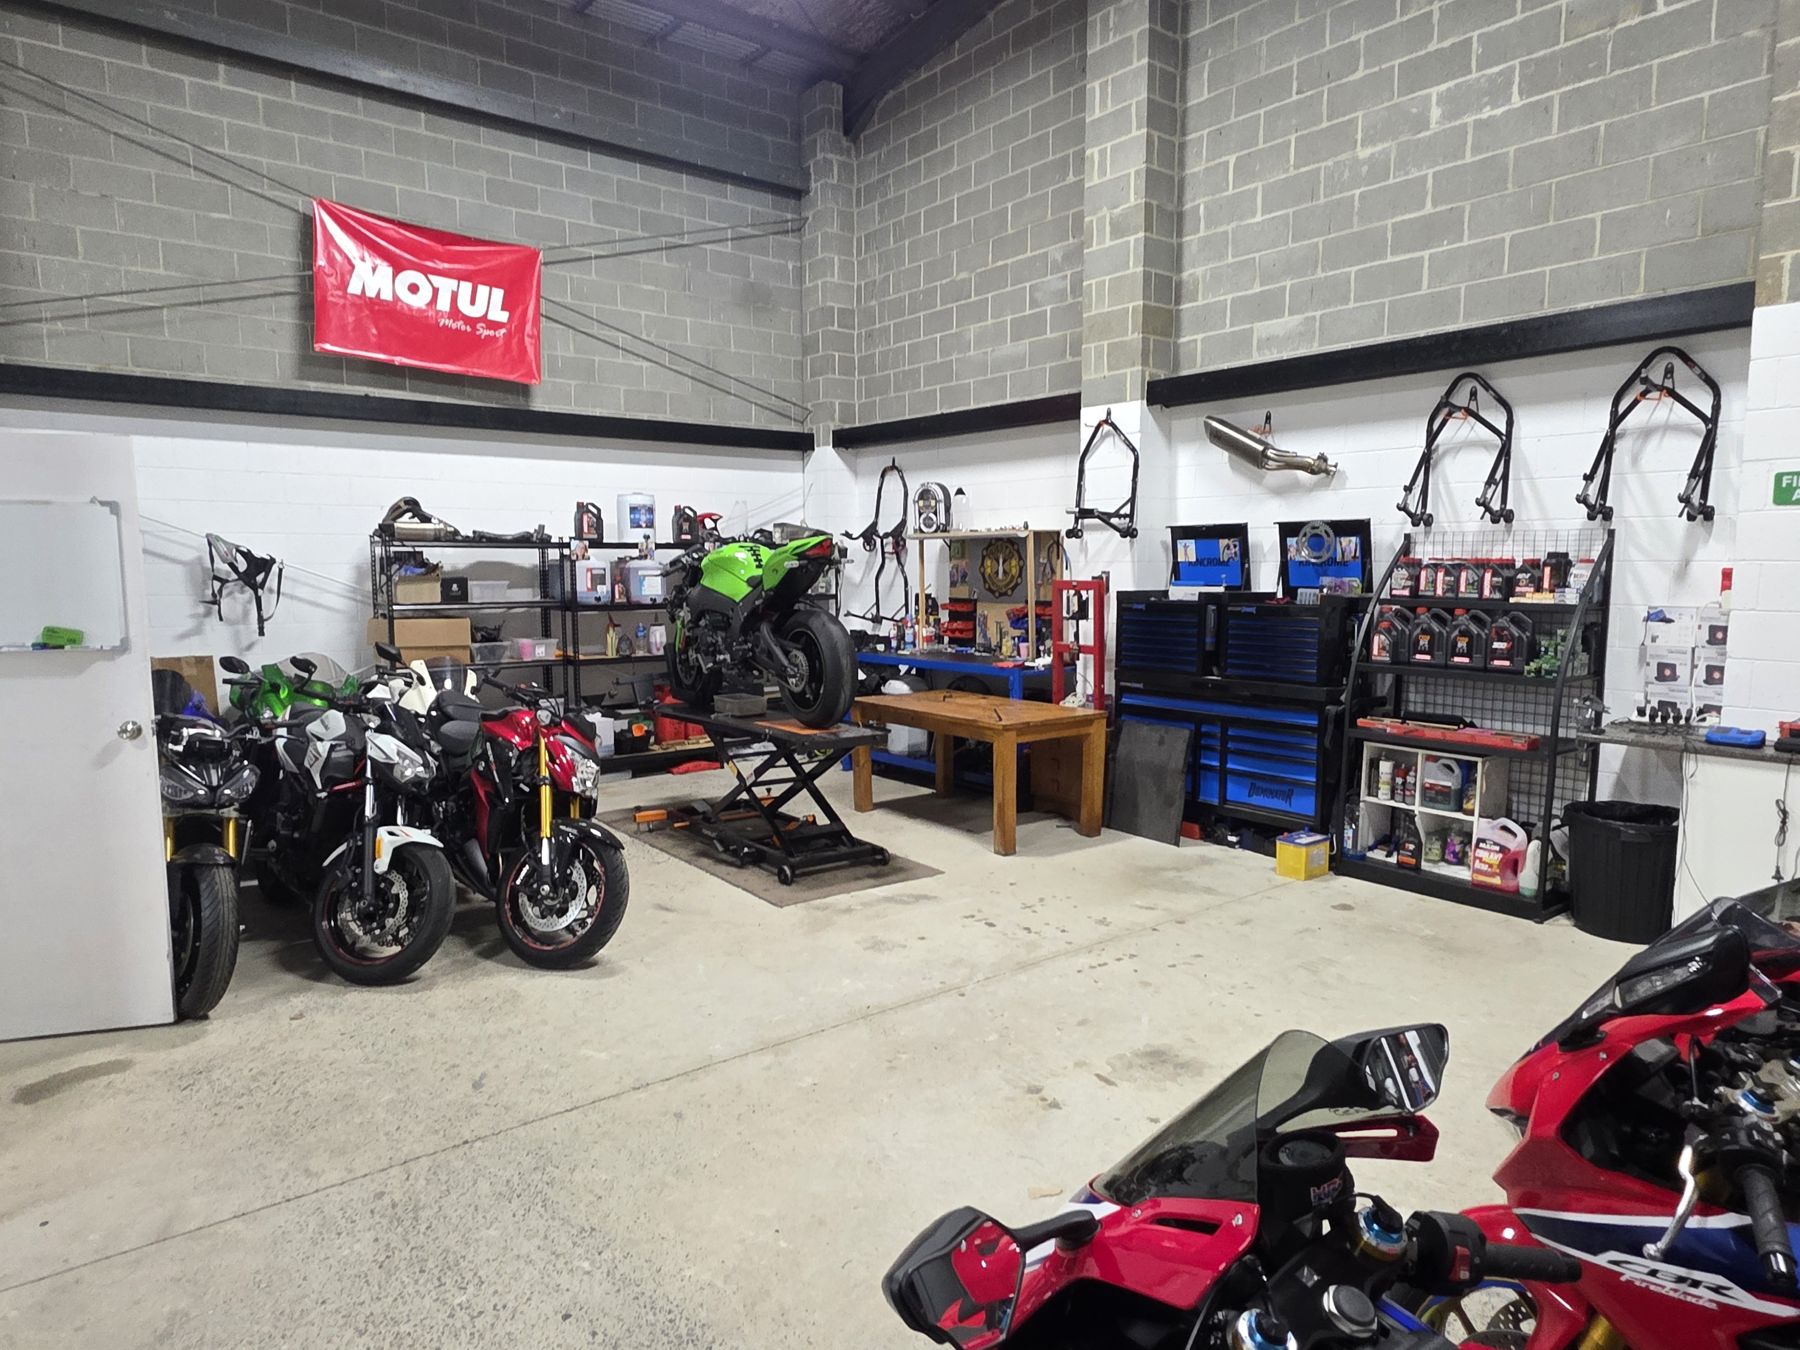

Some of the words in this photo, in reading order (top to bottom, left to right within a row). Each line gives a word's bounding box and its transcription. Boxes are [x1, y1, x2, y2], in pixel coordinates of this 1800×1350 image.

[347, 261, 509, 323] MOTUL
[437, 318, 472, 333] Motor
[475, 322, 507, 339] Sport
[1782, 475, 1800, 488] FI
[1606, 1259, 1744, 1303] CBR
